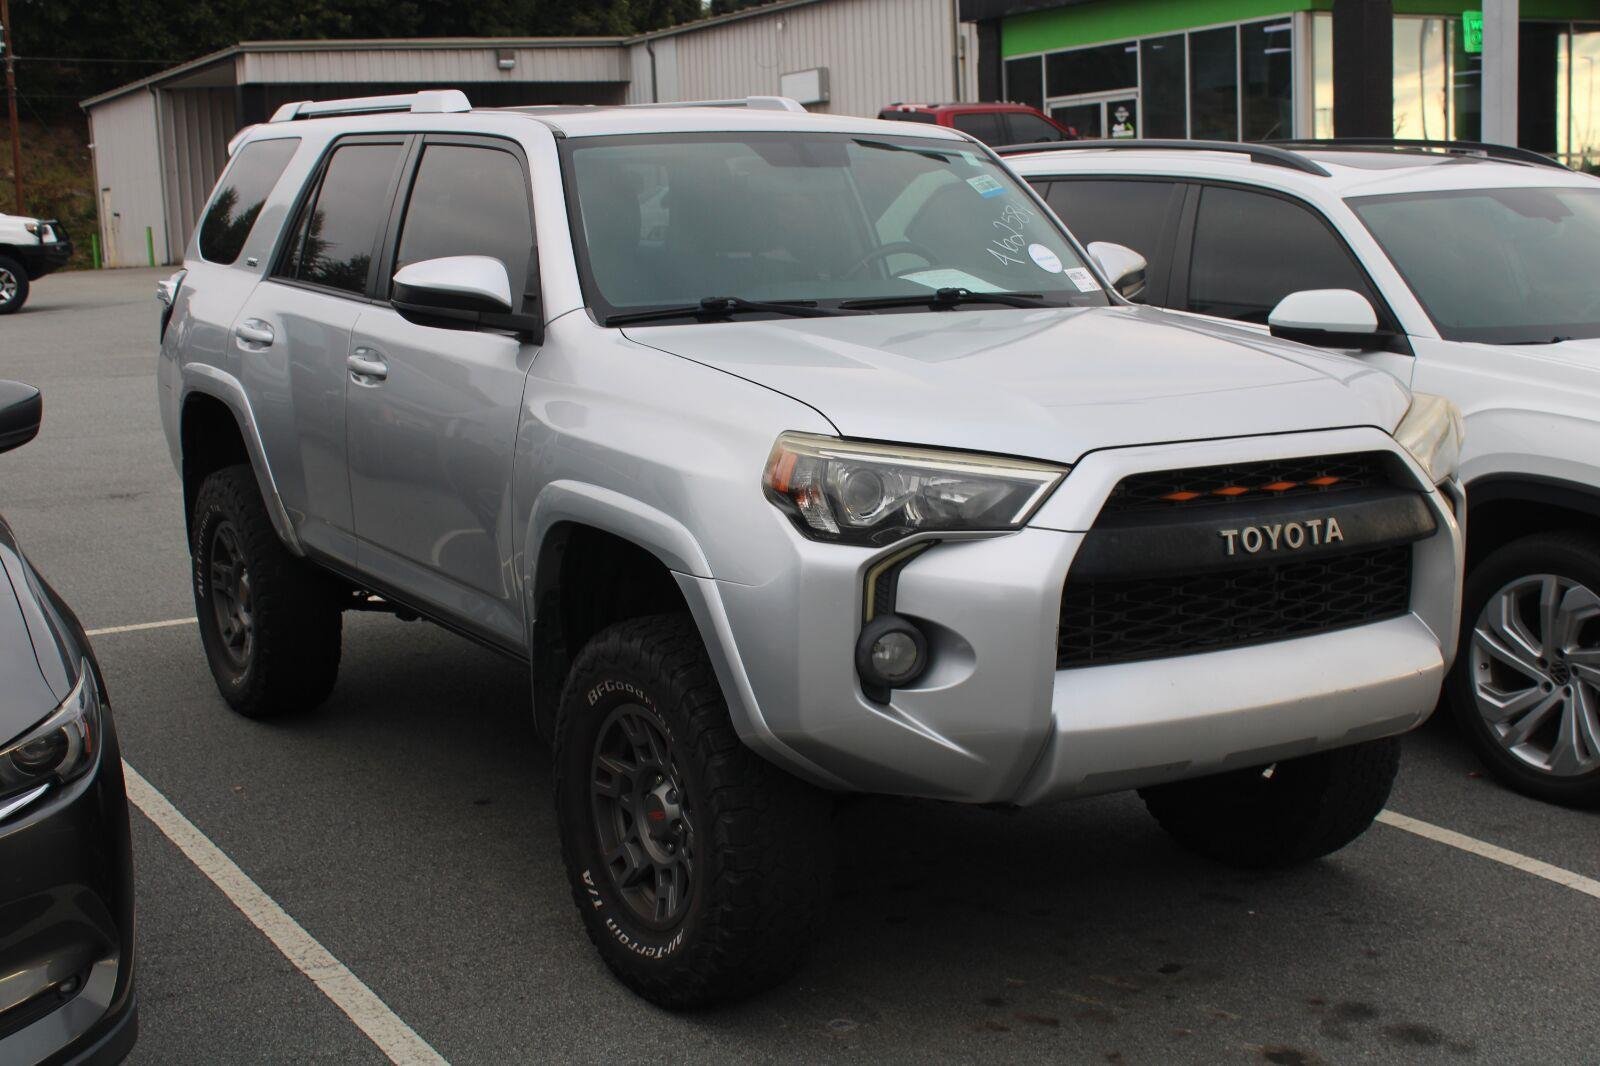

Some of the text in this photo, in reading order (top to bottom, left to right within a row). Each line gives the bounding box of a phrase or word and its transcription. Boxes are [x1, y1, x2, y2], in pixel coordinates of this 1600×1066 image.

[1219, 517, 1344, 556] TOYOTA
[581, 869, 684, 960] All-Terrain T/A
